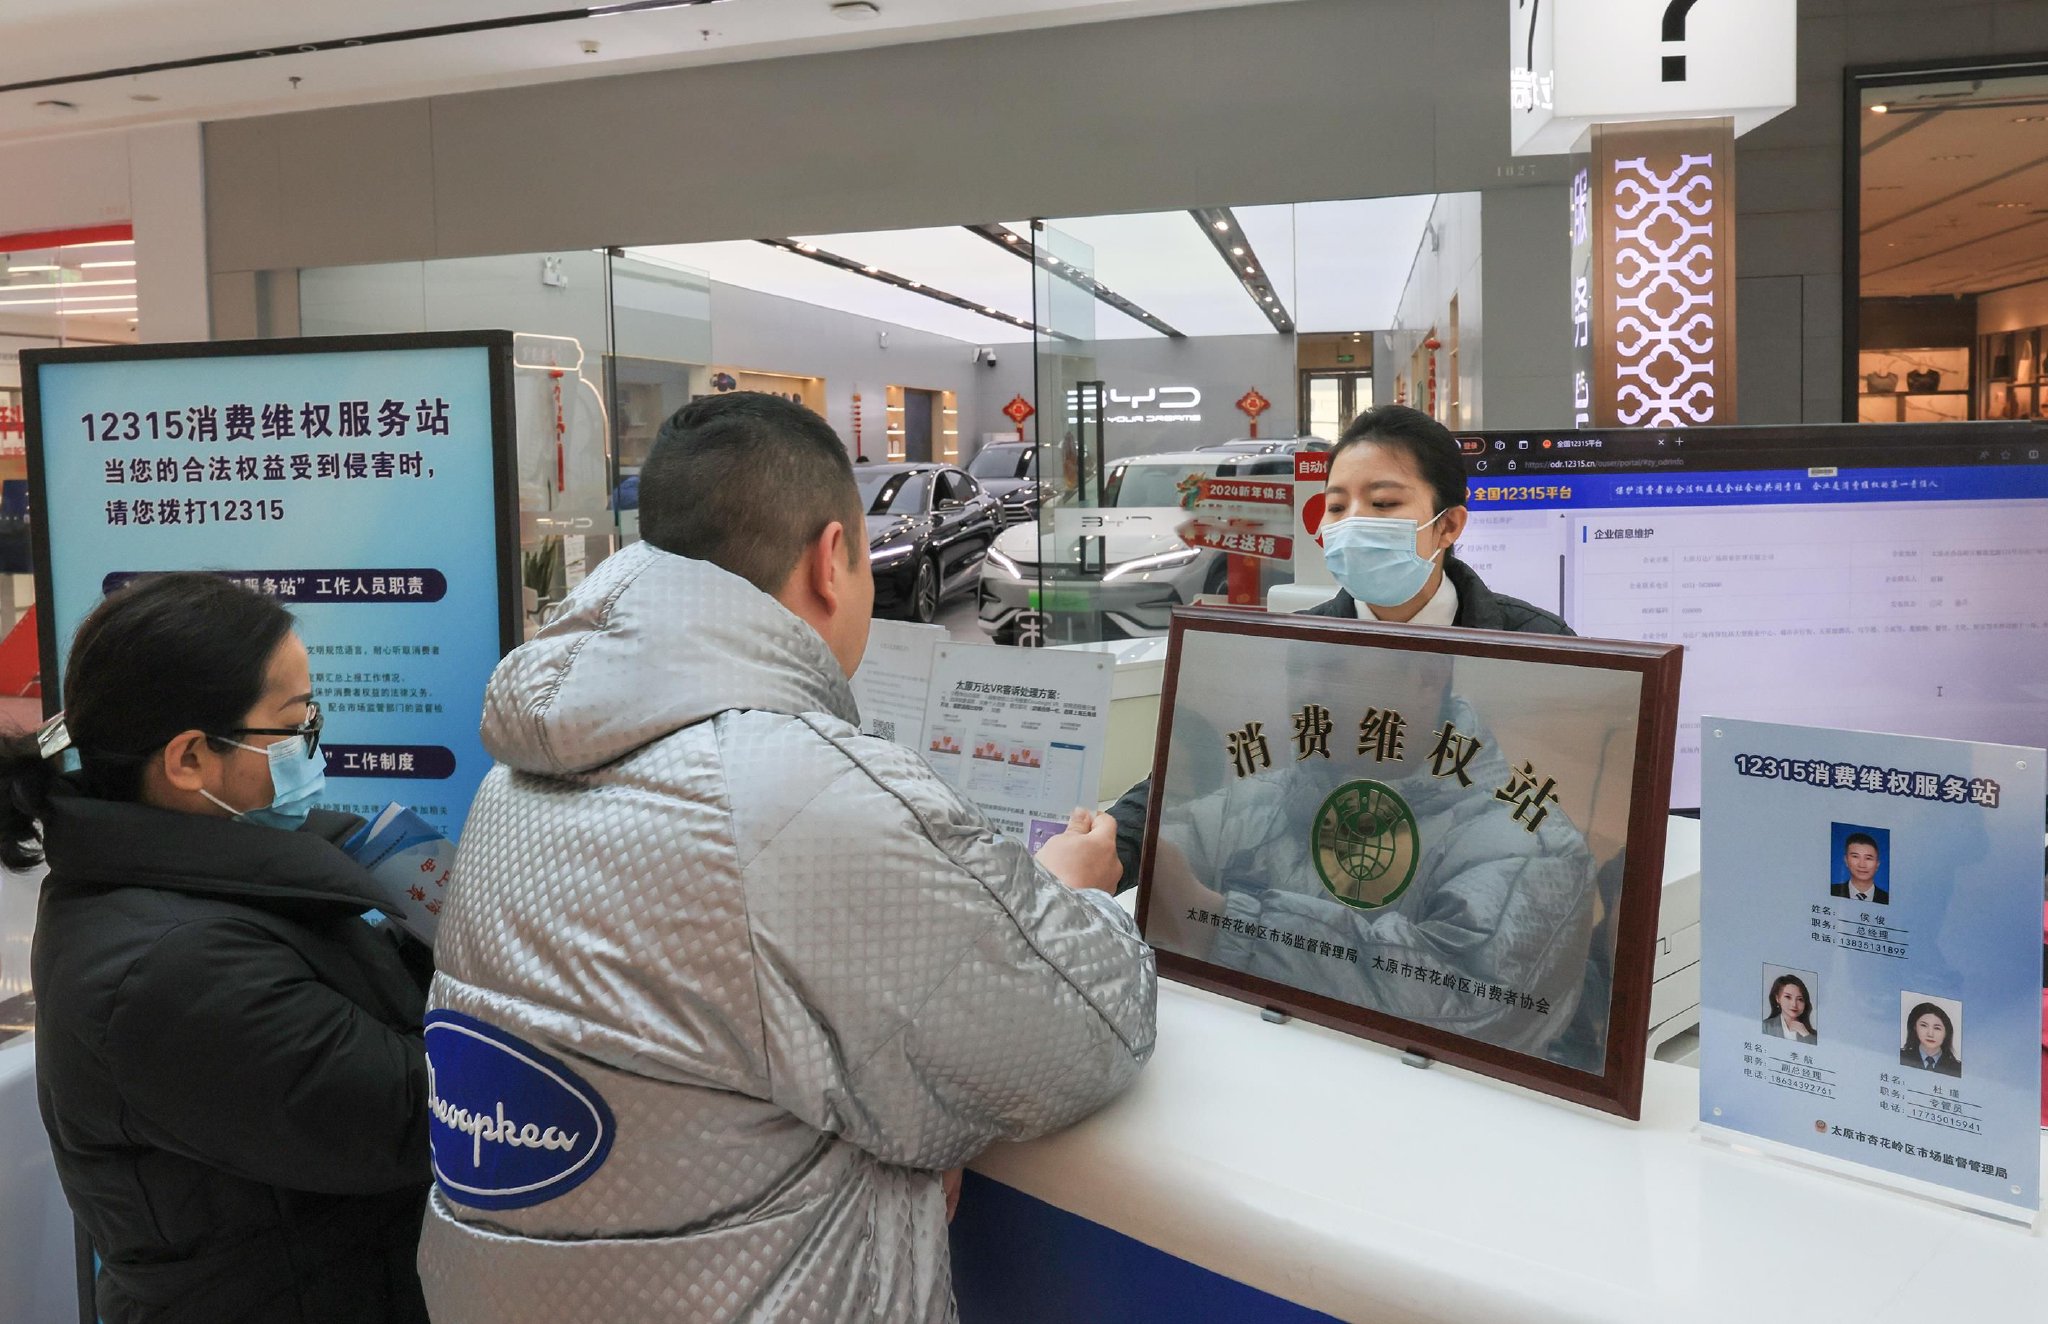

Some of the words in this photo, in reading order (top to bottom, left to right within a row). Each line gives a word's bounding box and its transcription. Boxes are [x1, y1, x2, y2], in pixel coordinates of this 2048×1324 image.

[82, 398, 451, 443] 12315消费维权服务站
[104, 450, 436, 484] 当您的合法权益受到侵害时，
[1210, 484, 1287, 500] 2024新年快乐
[1474, 486, 1572, 501] 全国12315平台
[106, 498, 284, 526] 请您拨打12315
[1594, 528, 1655, 540] 企业信息维护
[316, 576, 424, 596] 工作人员职责
[344, 752, 415, 772] 工作制度
[1226, 703, 1561, 833] 消费维权站
[1735, 754, 2000, 808] 12315消费维权服务站
[1811, 904, 1836, 916] 姓名：
[1811, 917, 1836, 930] 职务：
[1857, 926, 1889, 940] 总经理
[1811, 932, 1836, 944] 电话：
[1840, 938, 1906, 956] 13835131899
[1186, 907, 1358, 964] 太原市杏花岭区市场监督管理局
[1371, 955, 1551, 1015] 太原市杏花岭区消费者协会
[1781, 1063, 1821, 1080] 副总经理
[1770, 1075, 1832, 1096] 18634392761
[1912, 1109, 1981, 1132] 17735015941
[1831, 1125, 2009, 1180] 太原市杏花岭区市场监督管理局
